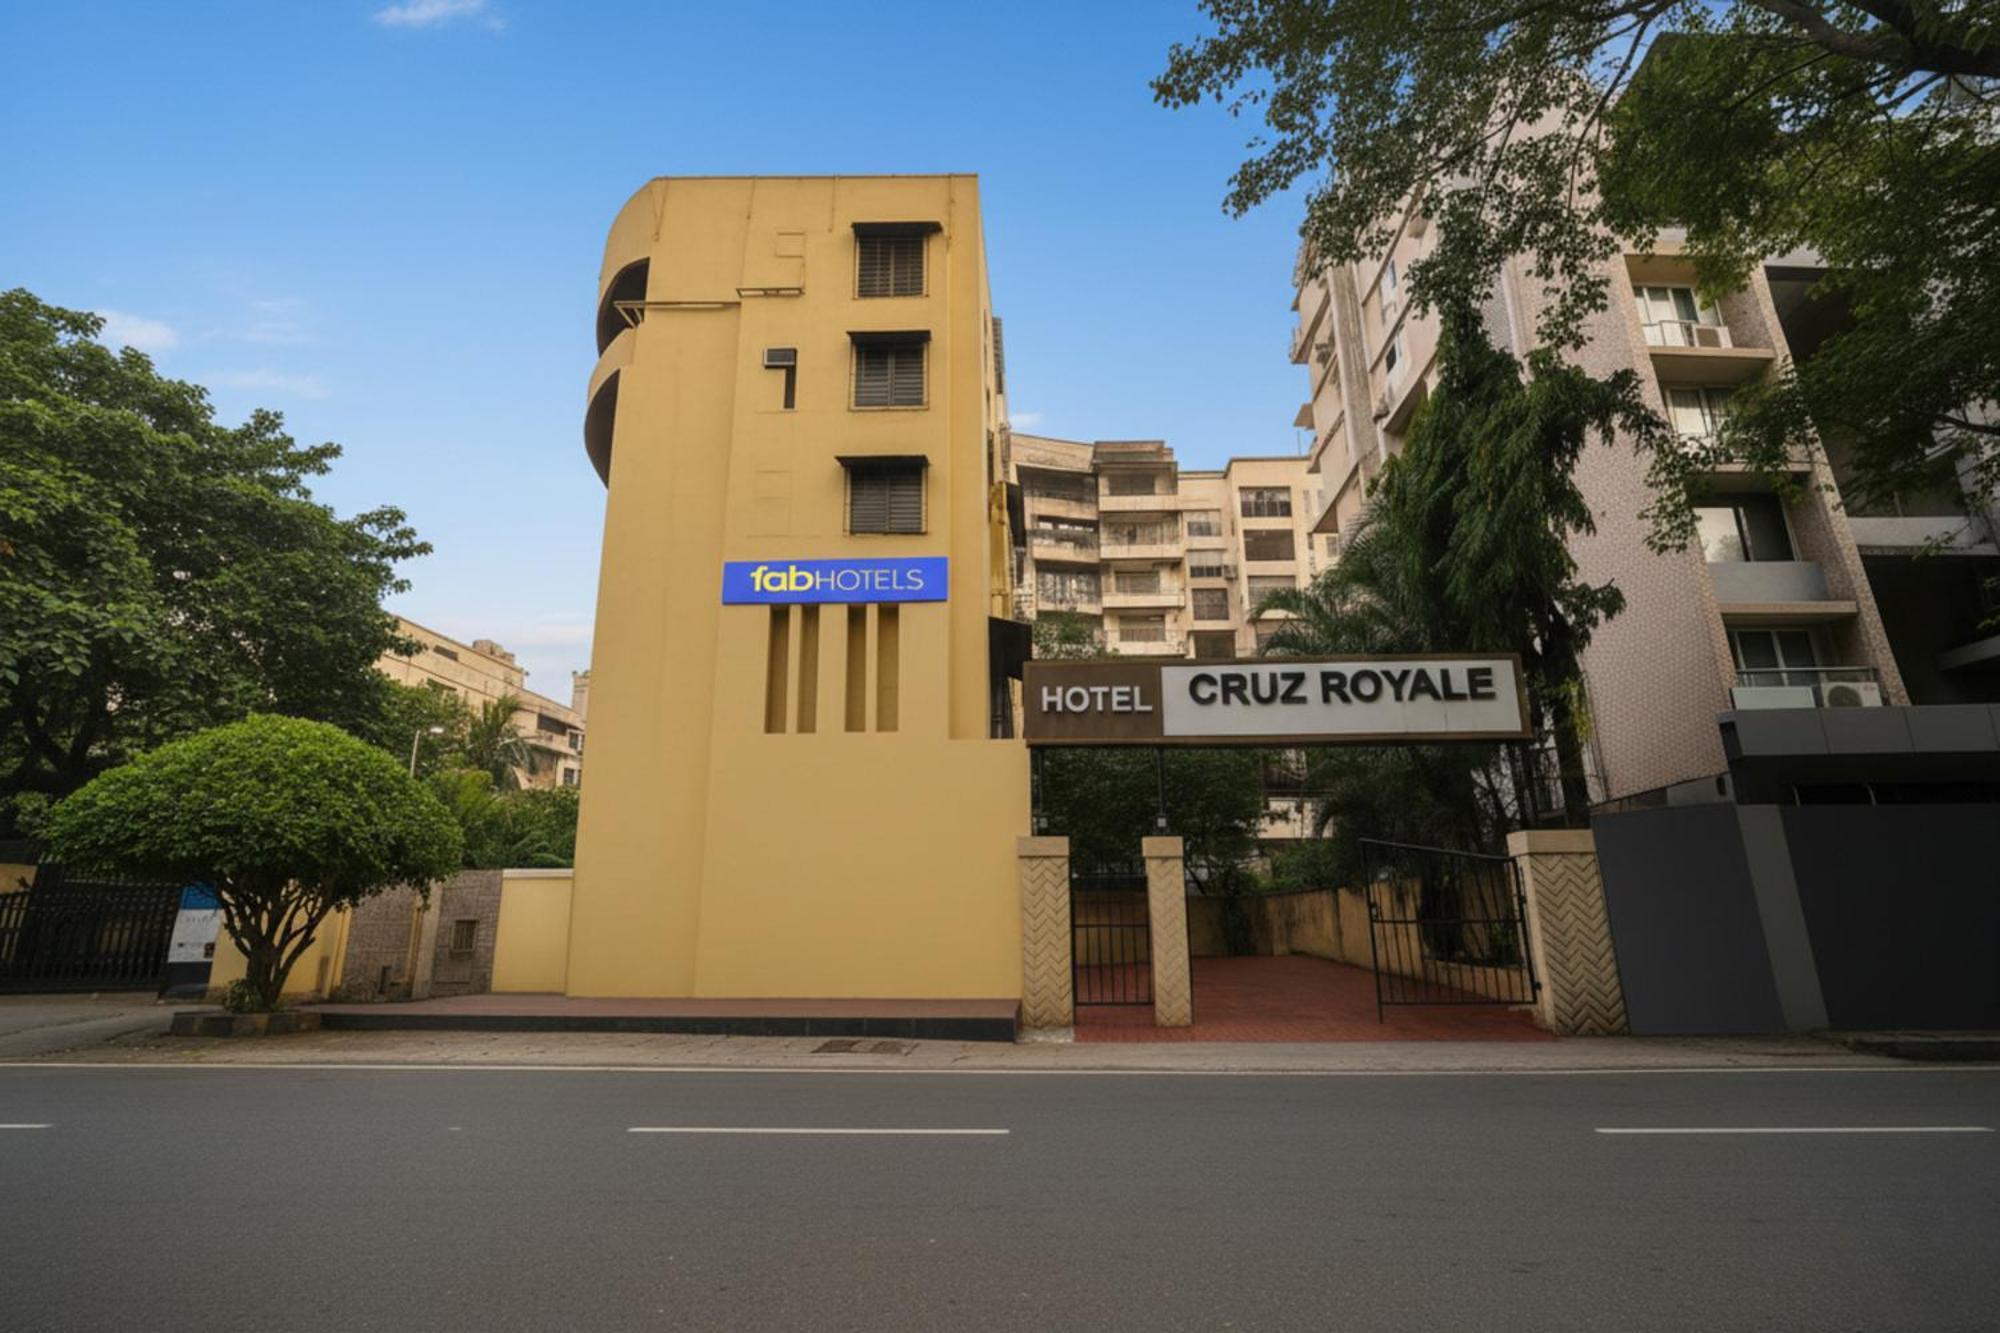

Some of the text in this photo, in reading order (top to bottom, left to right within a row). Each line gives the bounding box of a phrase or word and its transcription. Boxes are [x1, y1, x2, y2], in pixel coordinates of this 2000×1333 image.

[1041, 667, 1496, 713] HOTEL CRUZ ROYALE
